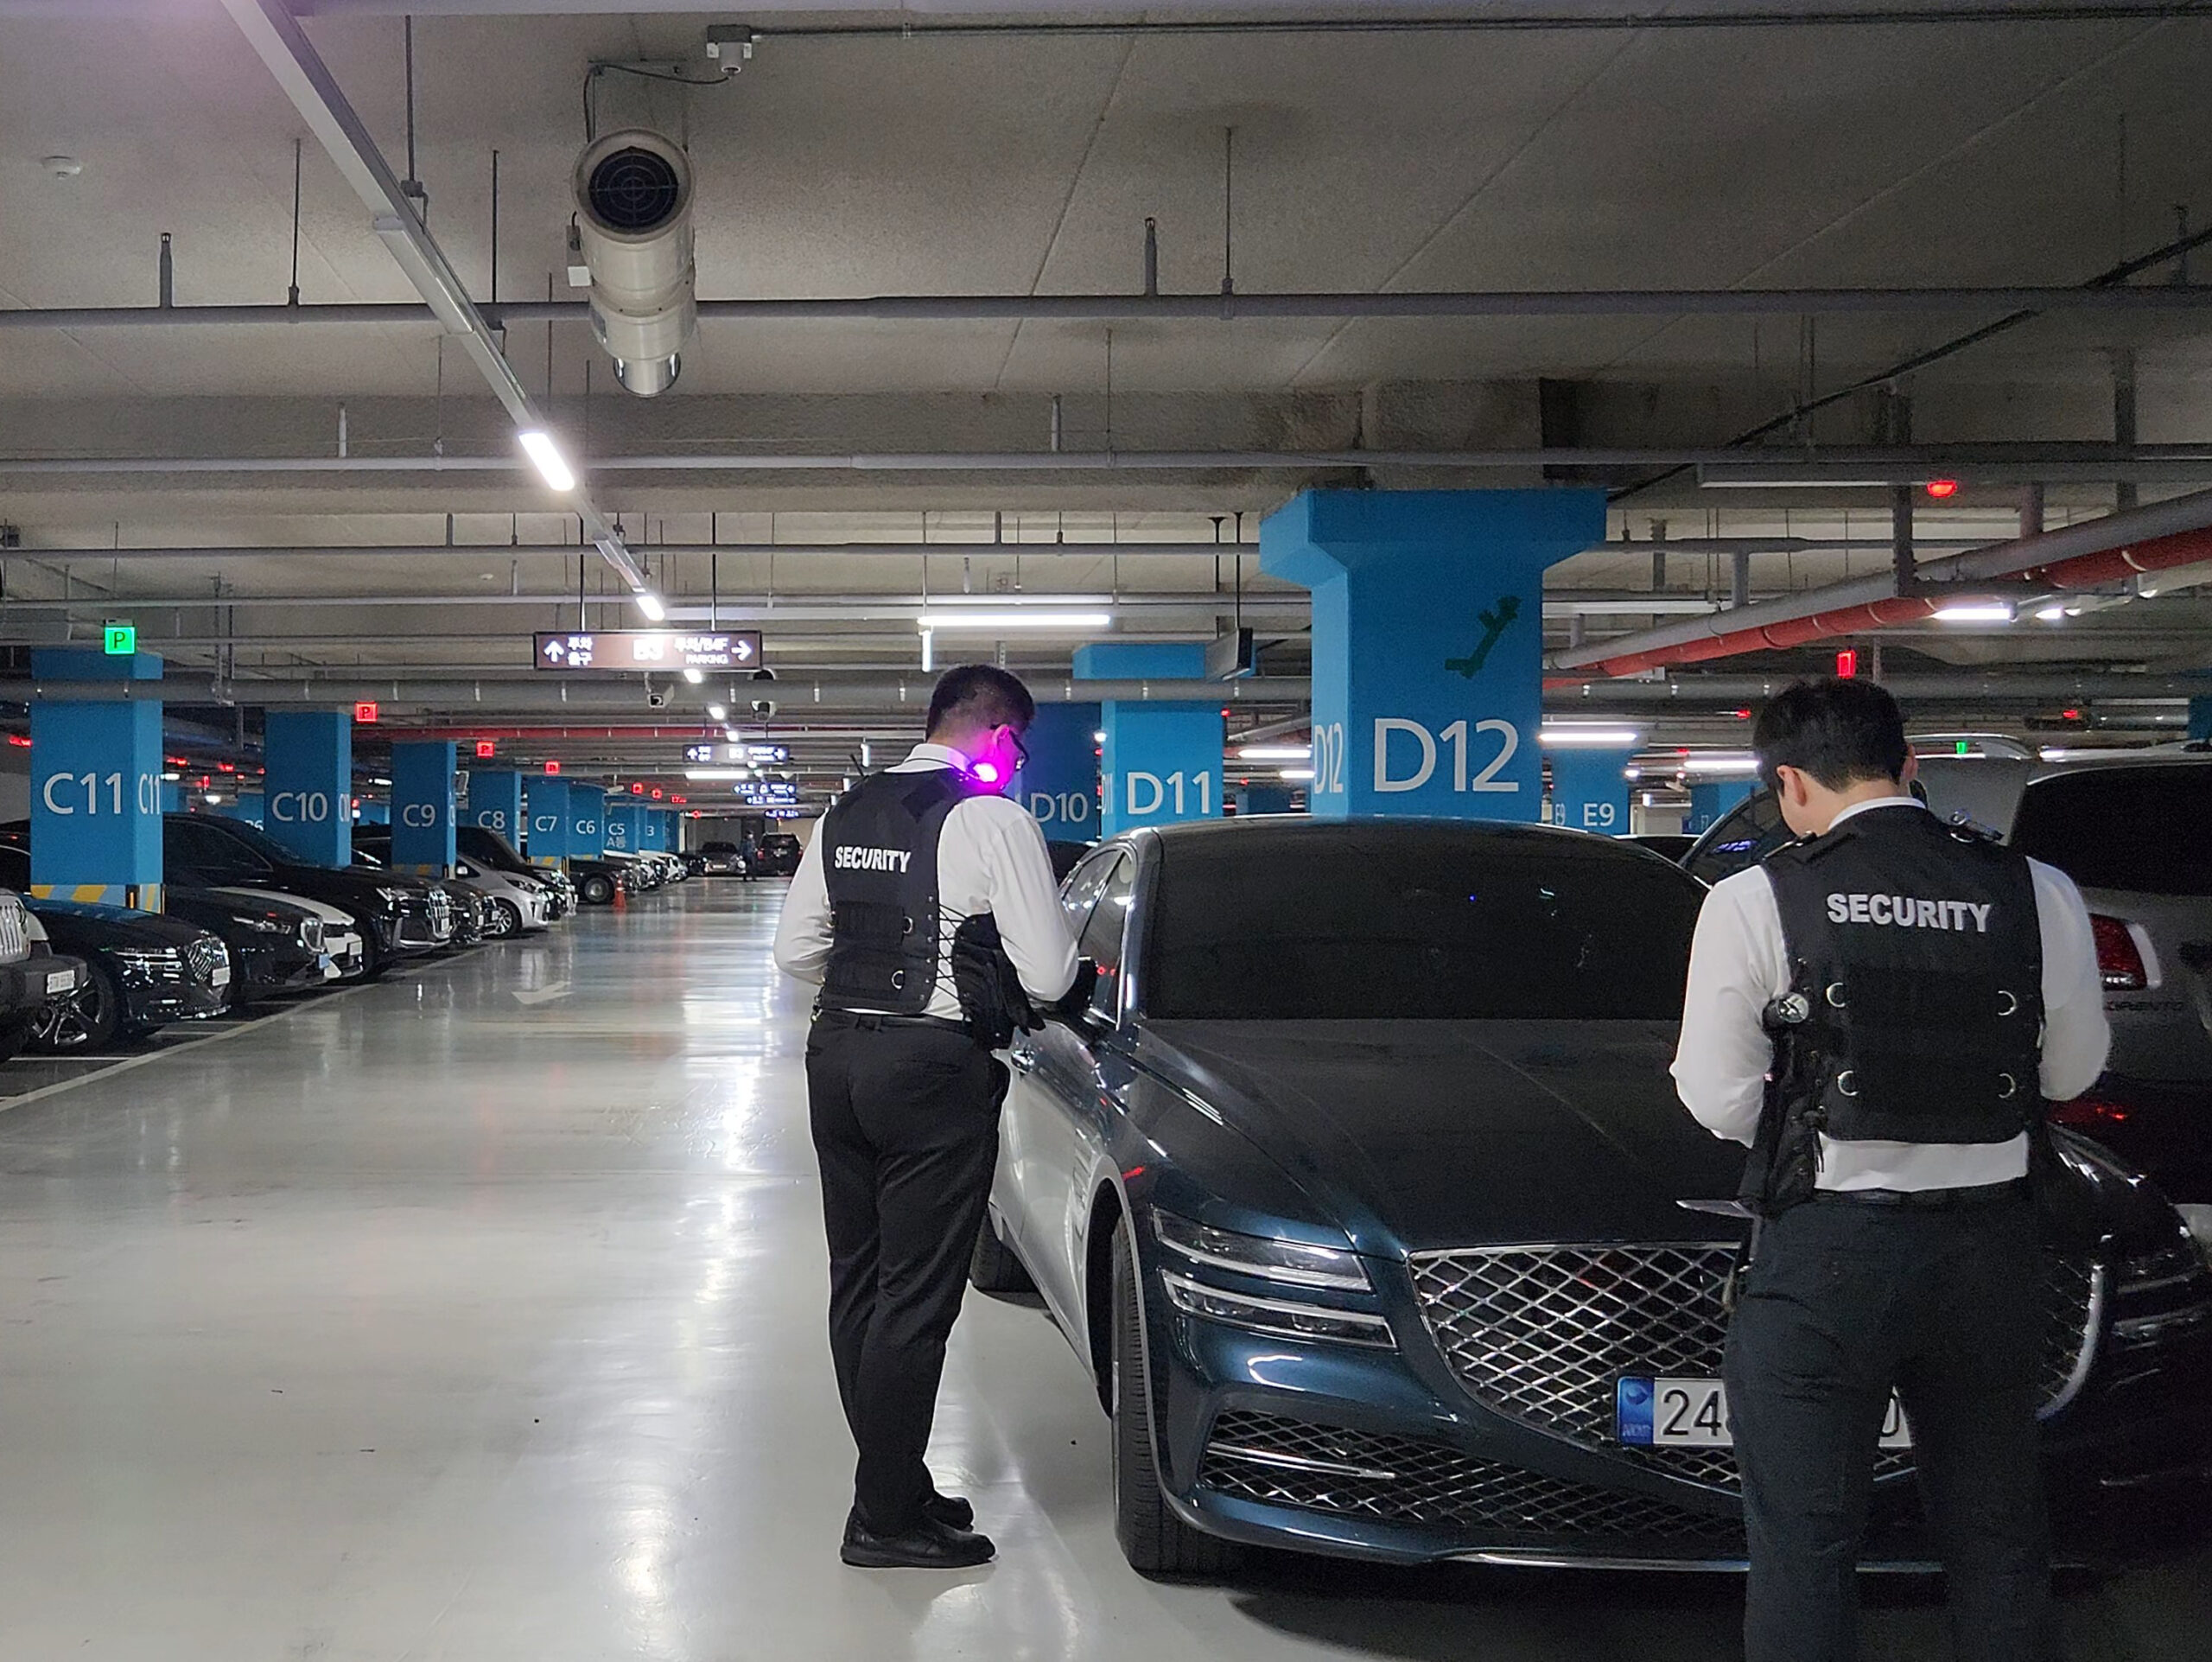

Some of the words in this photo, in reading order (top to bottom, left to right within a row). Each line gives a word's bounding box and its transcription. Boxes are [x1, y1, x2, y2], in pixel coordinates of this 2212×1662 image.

[114, 631, 125, 648] P
[685, 653, 728, 665] PARKING
[361, 706, 371, 720] P
[1314, 723, 1343, 793] D12
[1374, 718, 1519, 792] D12
[43, 772, 121, 814] C11
[138, 773, 160, 815] C11
[272, 792, 328, 821] C10
[1127, 771, 1210, 814] D11
[403, 804, 436, 827] C9
[478, 811, 505, 829] C8
[1031, 793, 1089, 822] D10
[1583, 803, 1615, 826] E9
[535, 816, 557, 831] C7
[575, 820, 595, 835] C6
[608, 823, 625, 836] C5
[834, 846, 912, 874] SECURITY
[1827, 893, 1991, 933] SECURITY
[1661, 1388, 1725, 1436] 24
